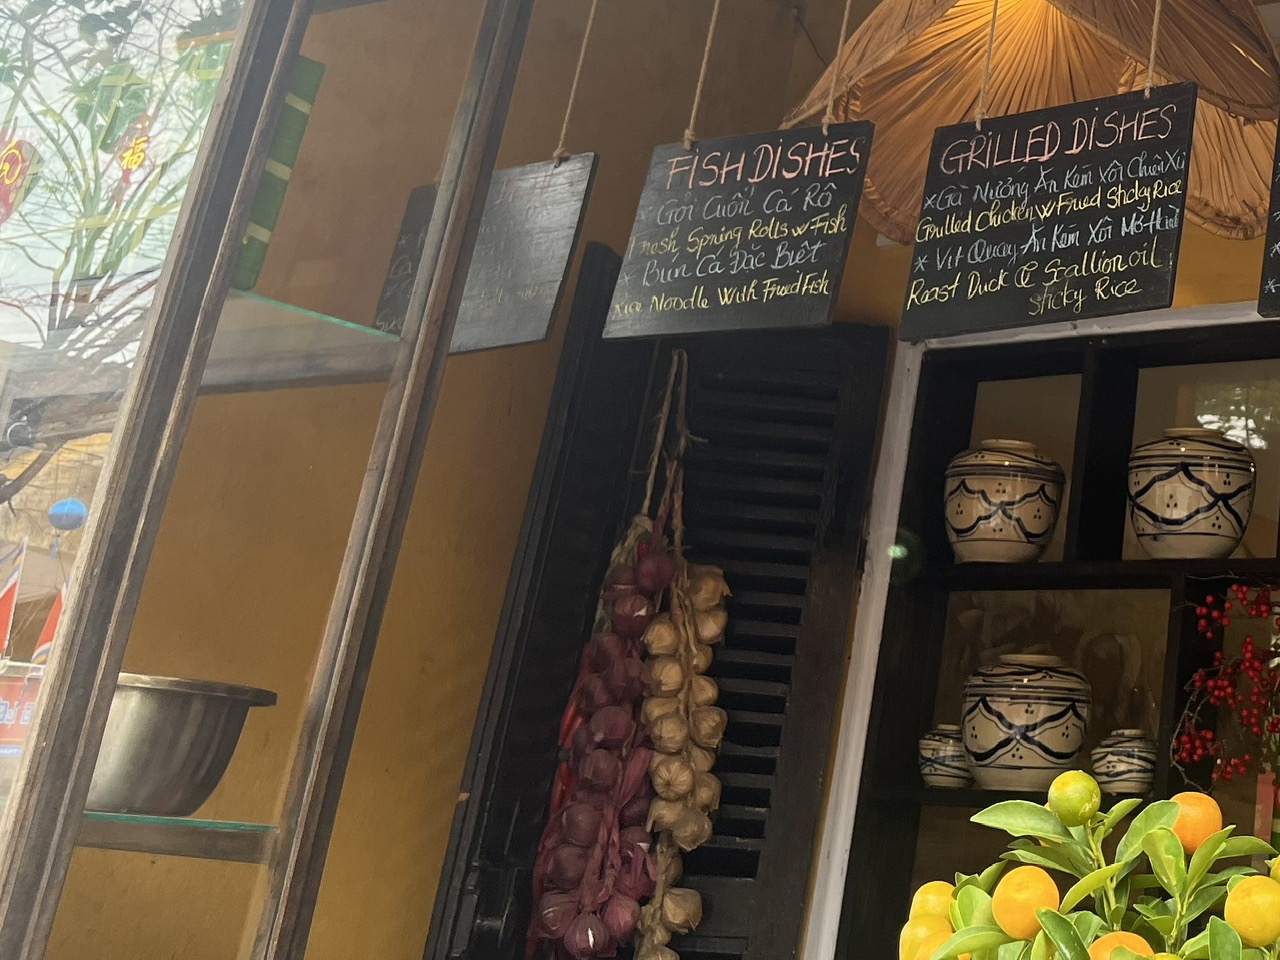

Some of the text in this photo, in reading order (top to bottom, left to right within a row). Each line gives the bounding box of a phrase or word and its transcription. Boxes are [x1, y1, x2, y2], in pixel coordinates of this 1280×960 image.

[940, 104, 1177, 175] GRILLED DISHES
[667, 136, 866, 190] FISH DISHES
[763, 187, 799, 215] Cá
[803, 182, 838, 212] Rô
[915, 208, 972, 243] Grilled
[975, 199, 1037, 232] Chicken
[1056, 185, 1102, 216] Fried
[1152, 179, 1183, 201] Rice
[936, 185, 969, 211] Gà
[628, 227, 681, 260] Fresh
[686, 223, 744, 260] Spring
[749, 216, 788, 241] Rolls
[810, 203, 848, 237] Fish
[967, 238, 1018, 267] Quay
[641, 253, 693, 287] Bún
[696, 245, 726, 278] Cá
[1094, 275, 1143, 300] Rice
[649, 285, 709, 314] Noodle
[717, 279, 759, 306] With
[762, 269, 801, 304] Fried
[802, 269, 830, 297] Fish
[906, 270, 962, 311] Roast
[967, 268, 1010, 300] Duck
